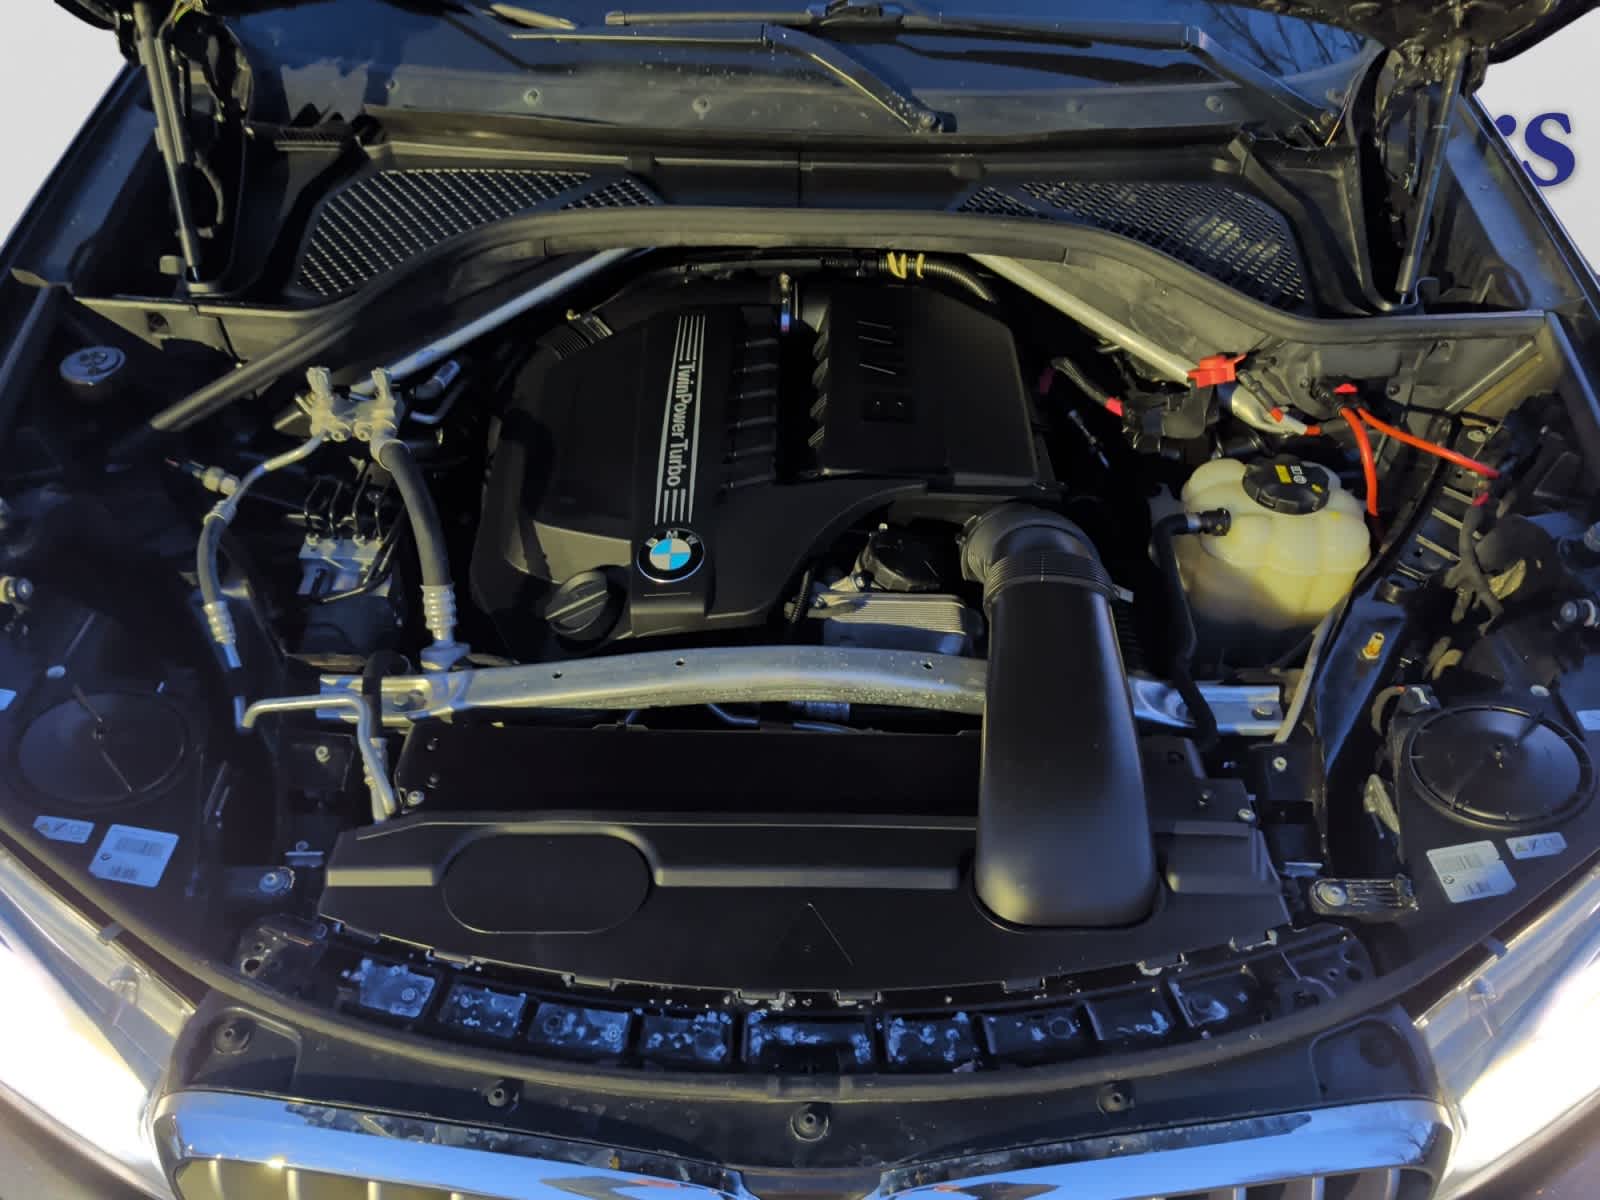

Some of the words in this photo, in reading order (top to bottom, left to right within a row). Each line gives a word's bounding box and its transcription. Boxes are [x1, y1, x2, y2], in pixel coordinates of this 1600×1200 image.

[1495, 112, 1575, 187] s
[671, 361, 695, 438] TwinPower
[667, 439, 689, 487] Turbo
